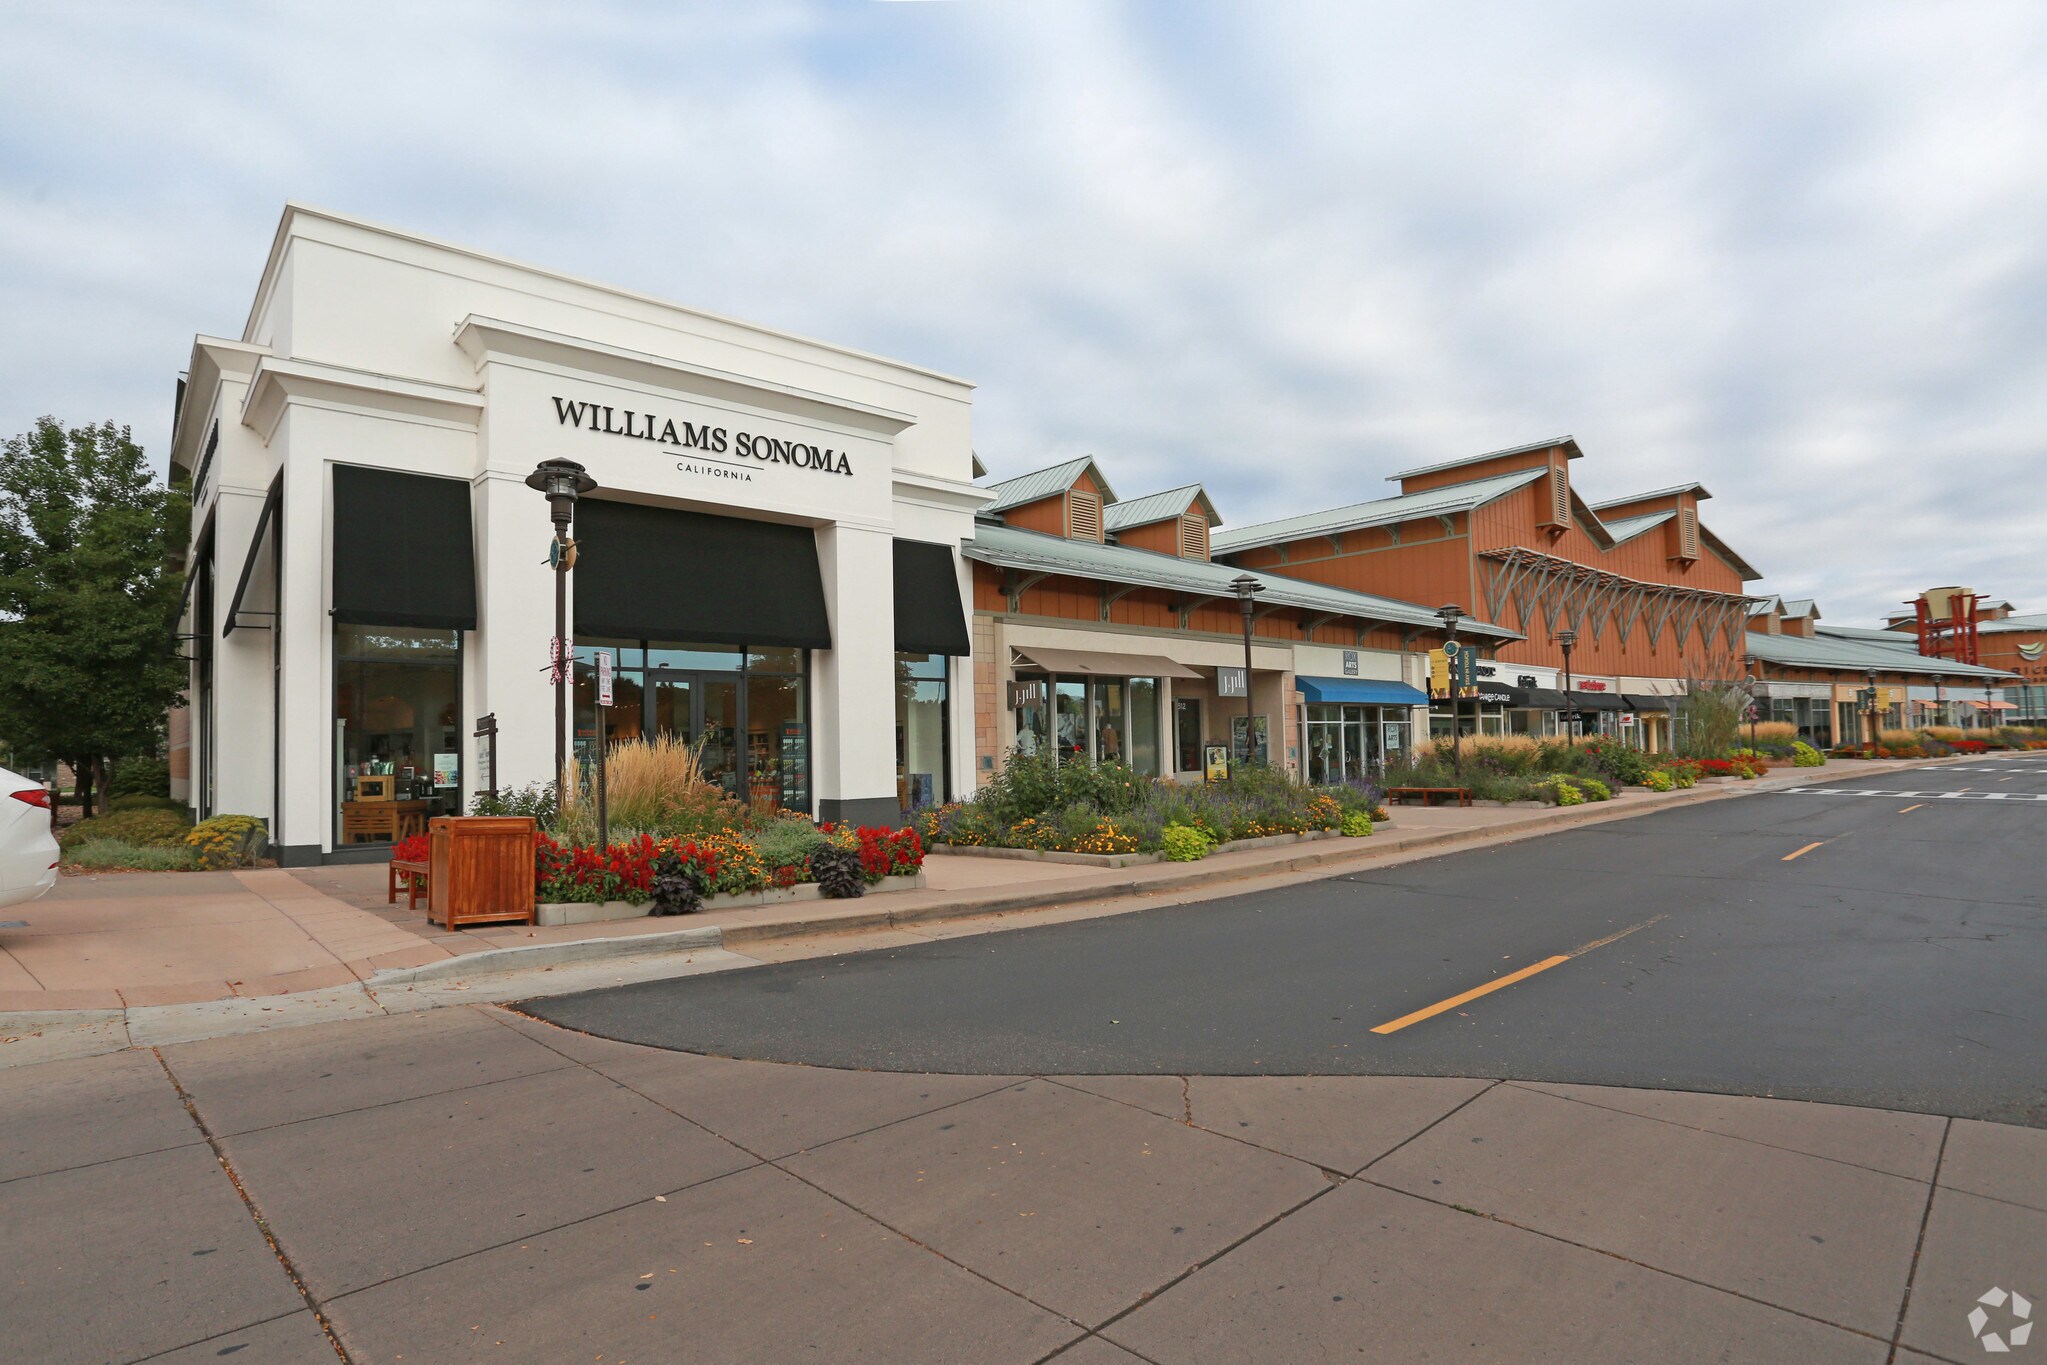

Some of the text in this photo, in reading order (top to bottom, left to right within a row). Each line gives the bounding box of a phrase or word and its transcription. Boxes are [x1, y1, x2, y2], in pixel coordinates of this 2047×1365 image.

[551, 396, 854, 476] WILLIAMS SONOMA
[676, 462, 752, 482] CALIFORNIA
[1345, 661, 1357, 669] ARTS
[1494, 693, 1510, 702] CANDLE
